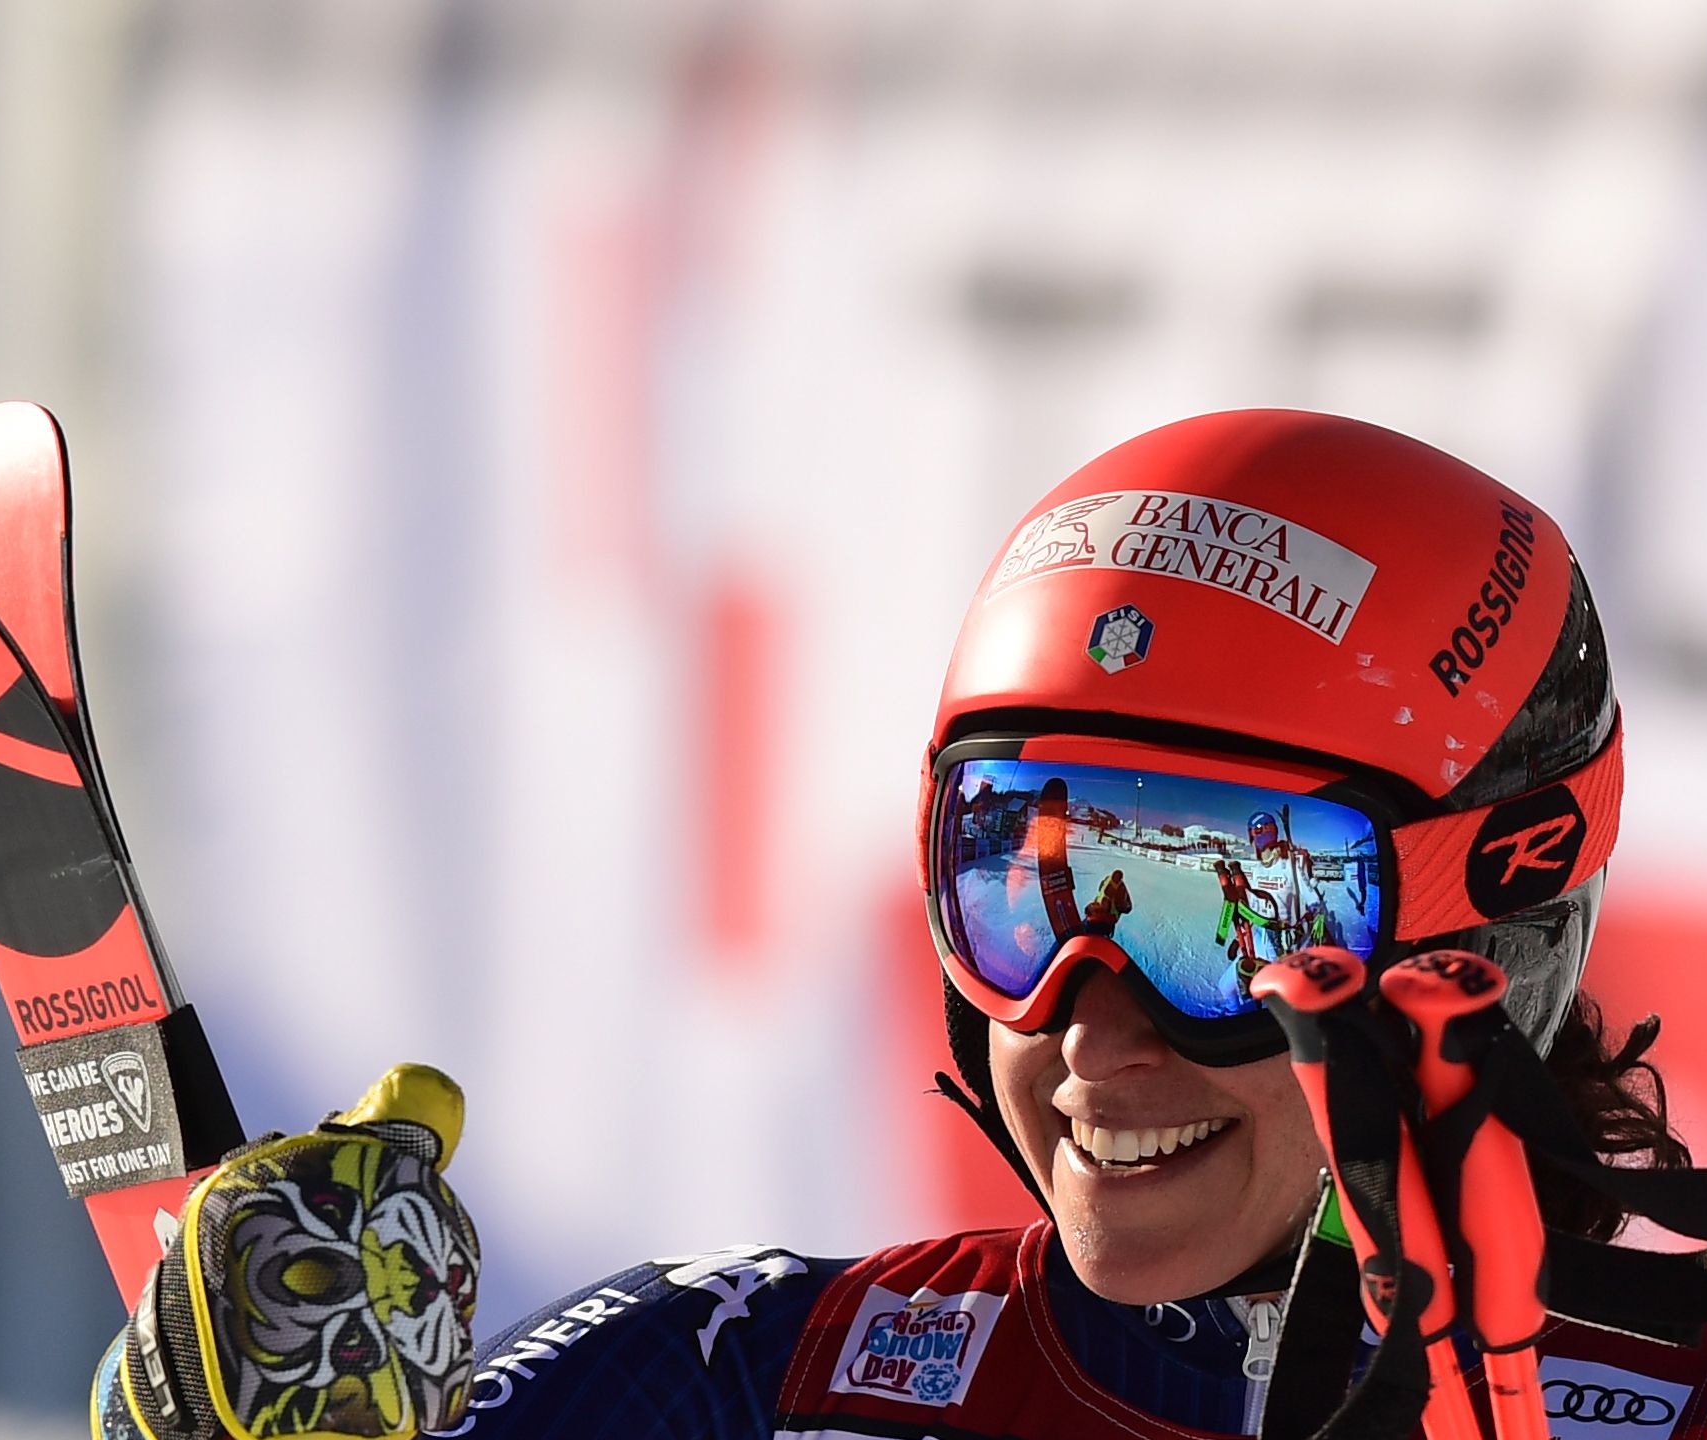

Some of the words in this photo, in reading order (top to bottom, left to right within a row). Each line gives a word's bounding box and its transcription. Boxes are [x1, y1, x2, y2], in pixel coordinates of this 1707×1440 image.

[1125, 494, 1291, 564] BANCA
[1111, 531, 1353, 640] GENERALI
[1429, 500, 1535, 698] ROSSIGNOL
[1107, 608, 1147, 627] FISI
[14, 974, 157, 1035] ROSSIGNOL
[25, 1072, 50, 1097] WE
[47, 1064, 81, 1092] CAN
[81, 1060, 102, 1086] BE
[41, 1101, 124, 1148] HEROES
[90, 1154, 119, 1179] FOR
[118, 1146, 149, 1173] ONE
[148, 1142, 172, 1166] DAY
[137, 1268, 177, 1418] LEVE
[892, 1310, 957, 1335] World
[861, 1353, 917, 1388] Day
